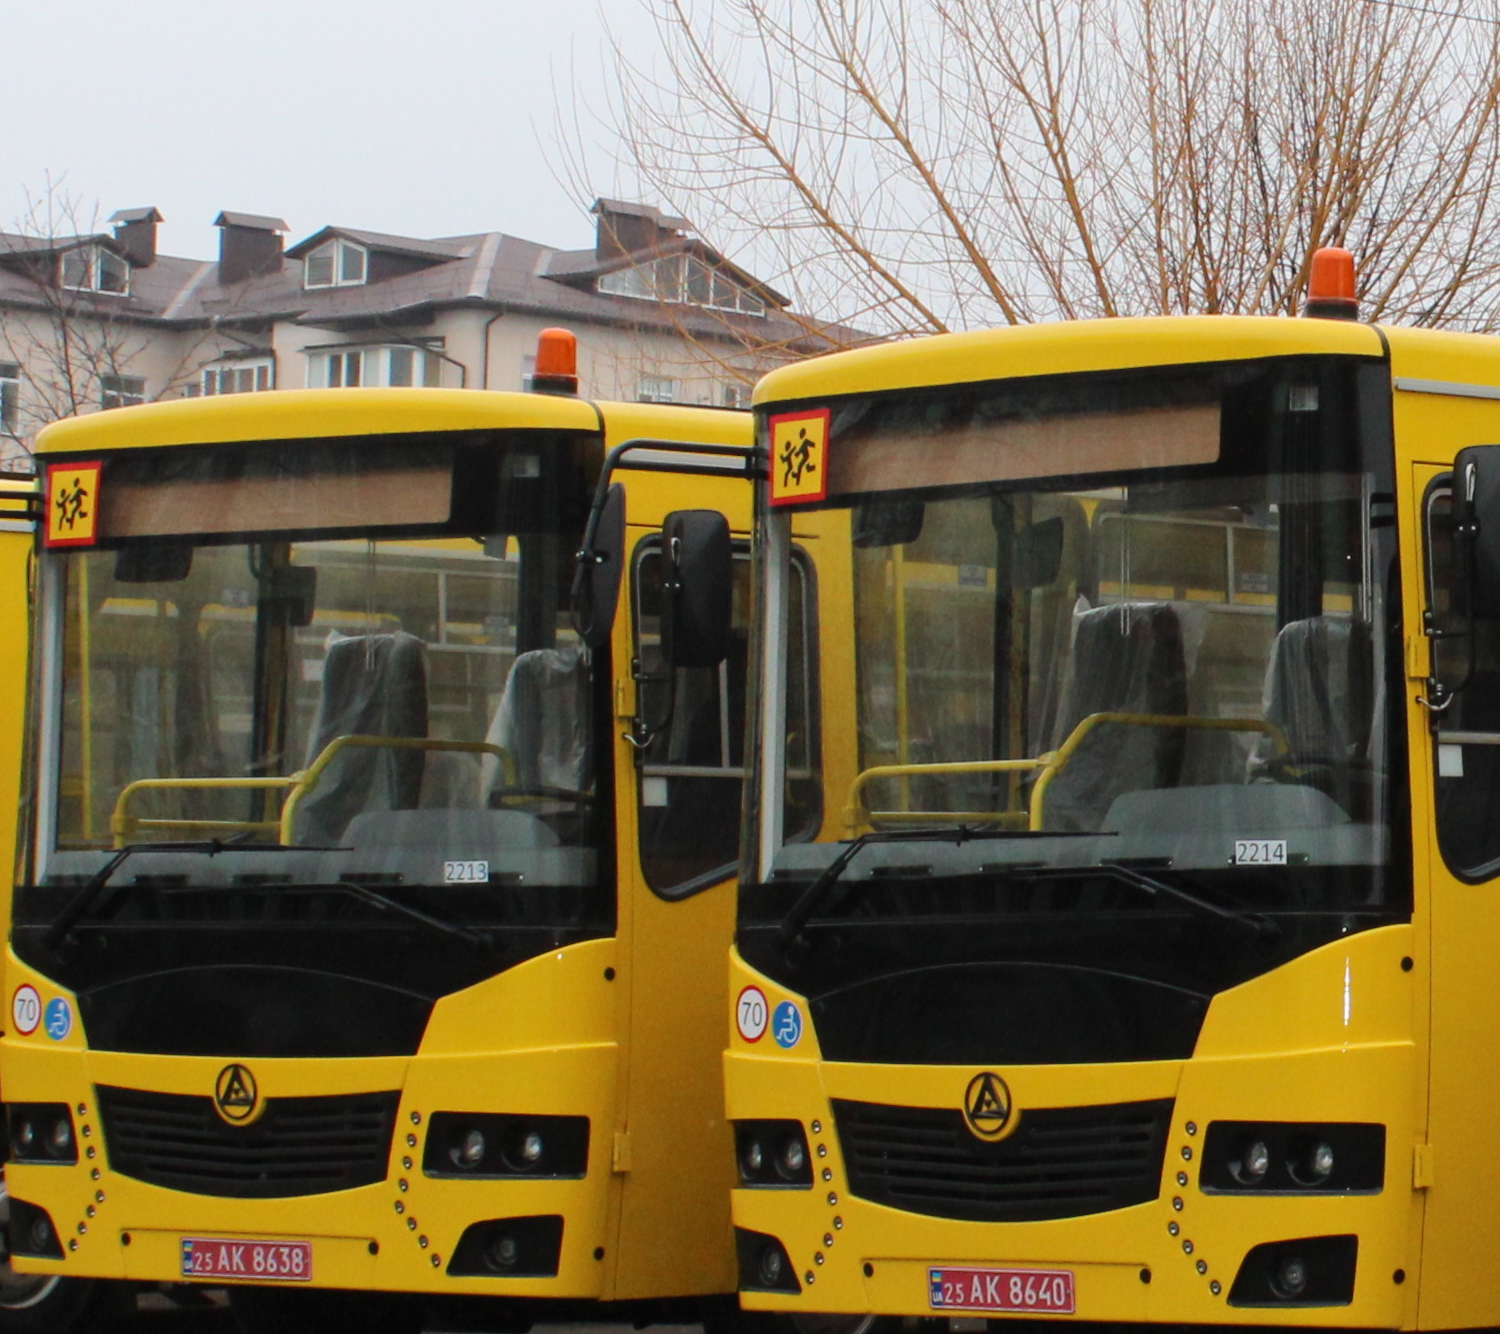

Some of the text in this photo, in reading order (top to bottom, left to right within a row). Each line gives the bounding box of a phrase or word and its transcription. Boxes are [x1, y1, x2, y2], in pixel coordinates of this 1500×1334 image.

[1237, 842, 1285, 862] 2214
[446, 862, 487, 881] 2213
[17, 998, 37, 1021] 70
[742, 1002, 763, 1027] 70
[194, 1252, 213, 1271] 25
[218, 1245, 246, 1271] AK
[253, 1246, 303, 1274] 8638
[944, 1283, 964, 1303] 25
[970, 1274, 1001, 1304] AK
[1009, 1276, 1066, 1306] 8640
